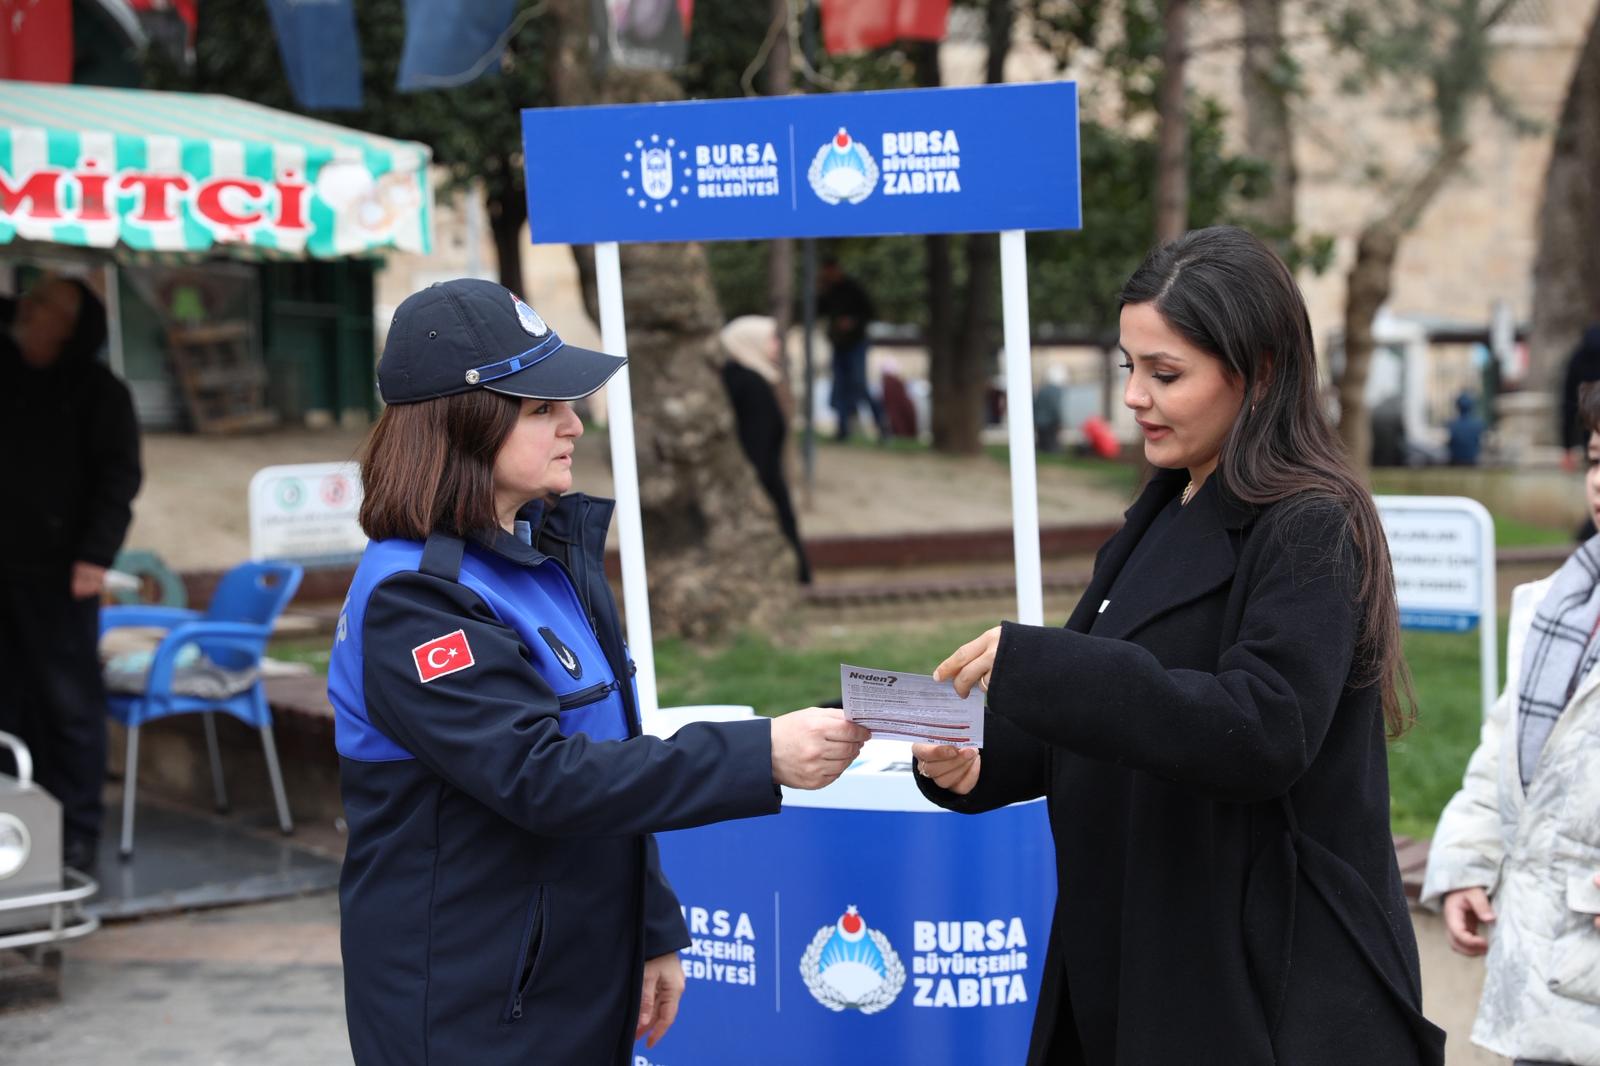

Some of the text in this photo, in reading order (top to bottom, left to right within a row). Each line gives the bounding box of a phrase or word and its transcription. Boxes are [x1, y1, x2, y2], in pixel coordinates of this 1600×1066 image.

[696, 143, 778, 166] BURSA
[882, 129, 960, 156] BURSA
[698, 177, 779, 198] BELEDİYESİ
[882, 171, 961, 195] ZABITA
[849, 671, 898, 687] Neden?
[914, 916, 1027, 952] BURSA
[913, 949, 1028, 978] BÜYÜKŞEHİR
[913, 973, 1028, 1008] ZABITA
